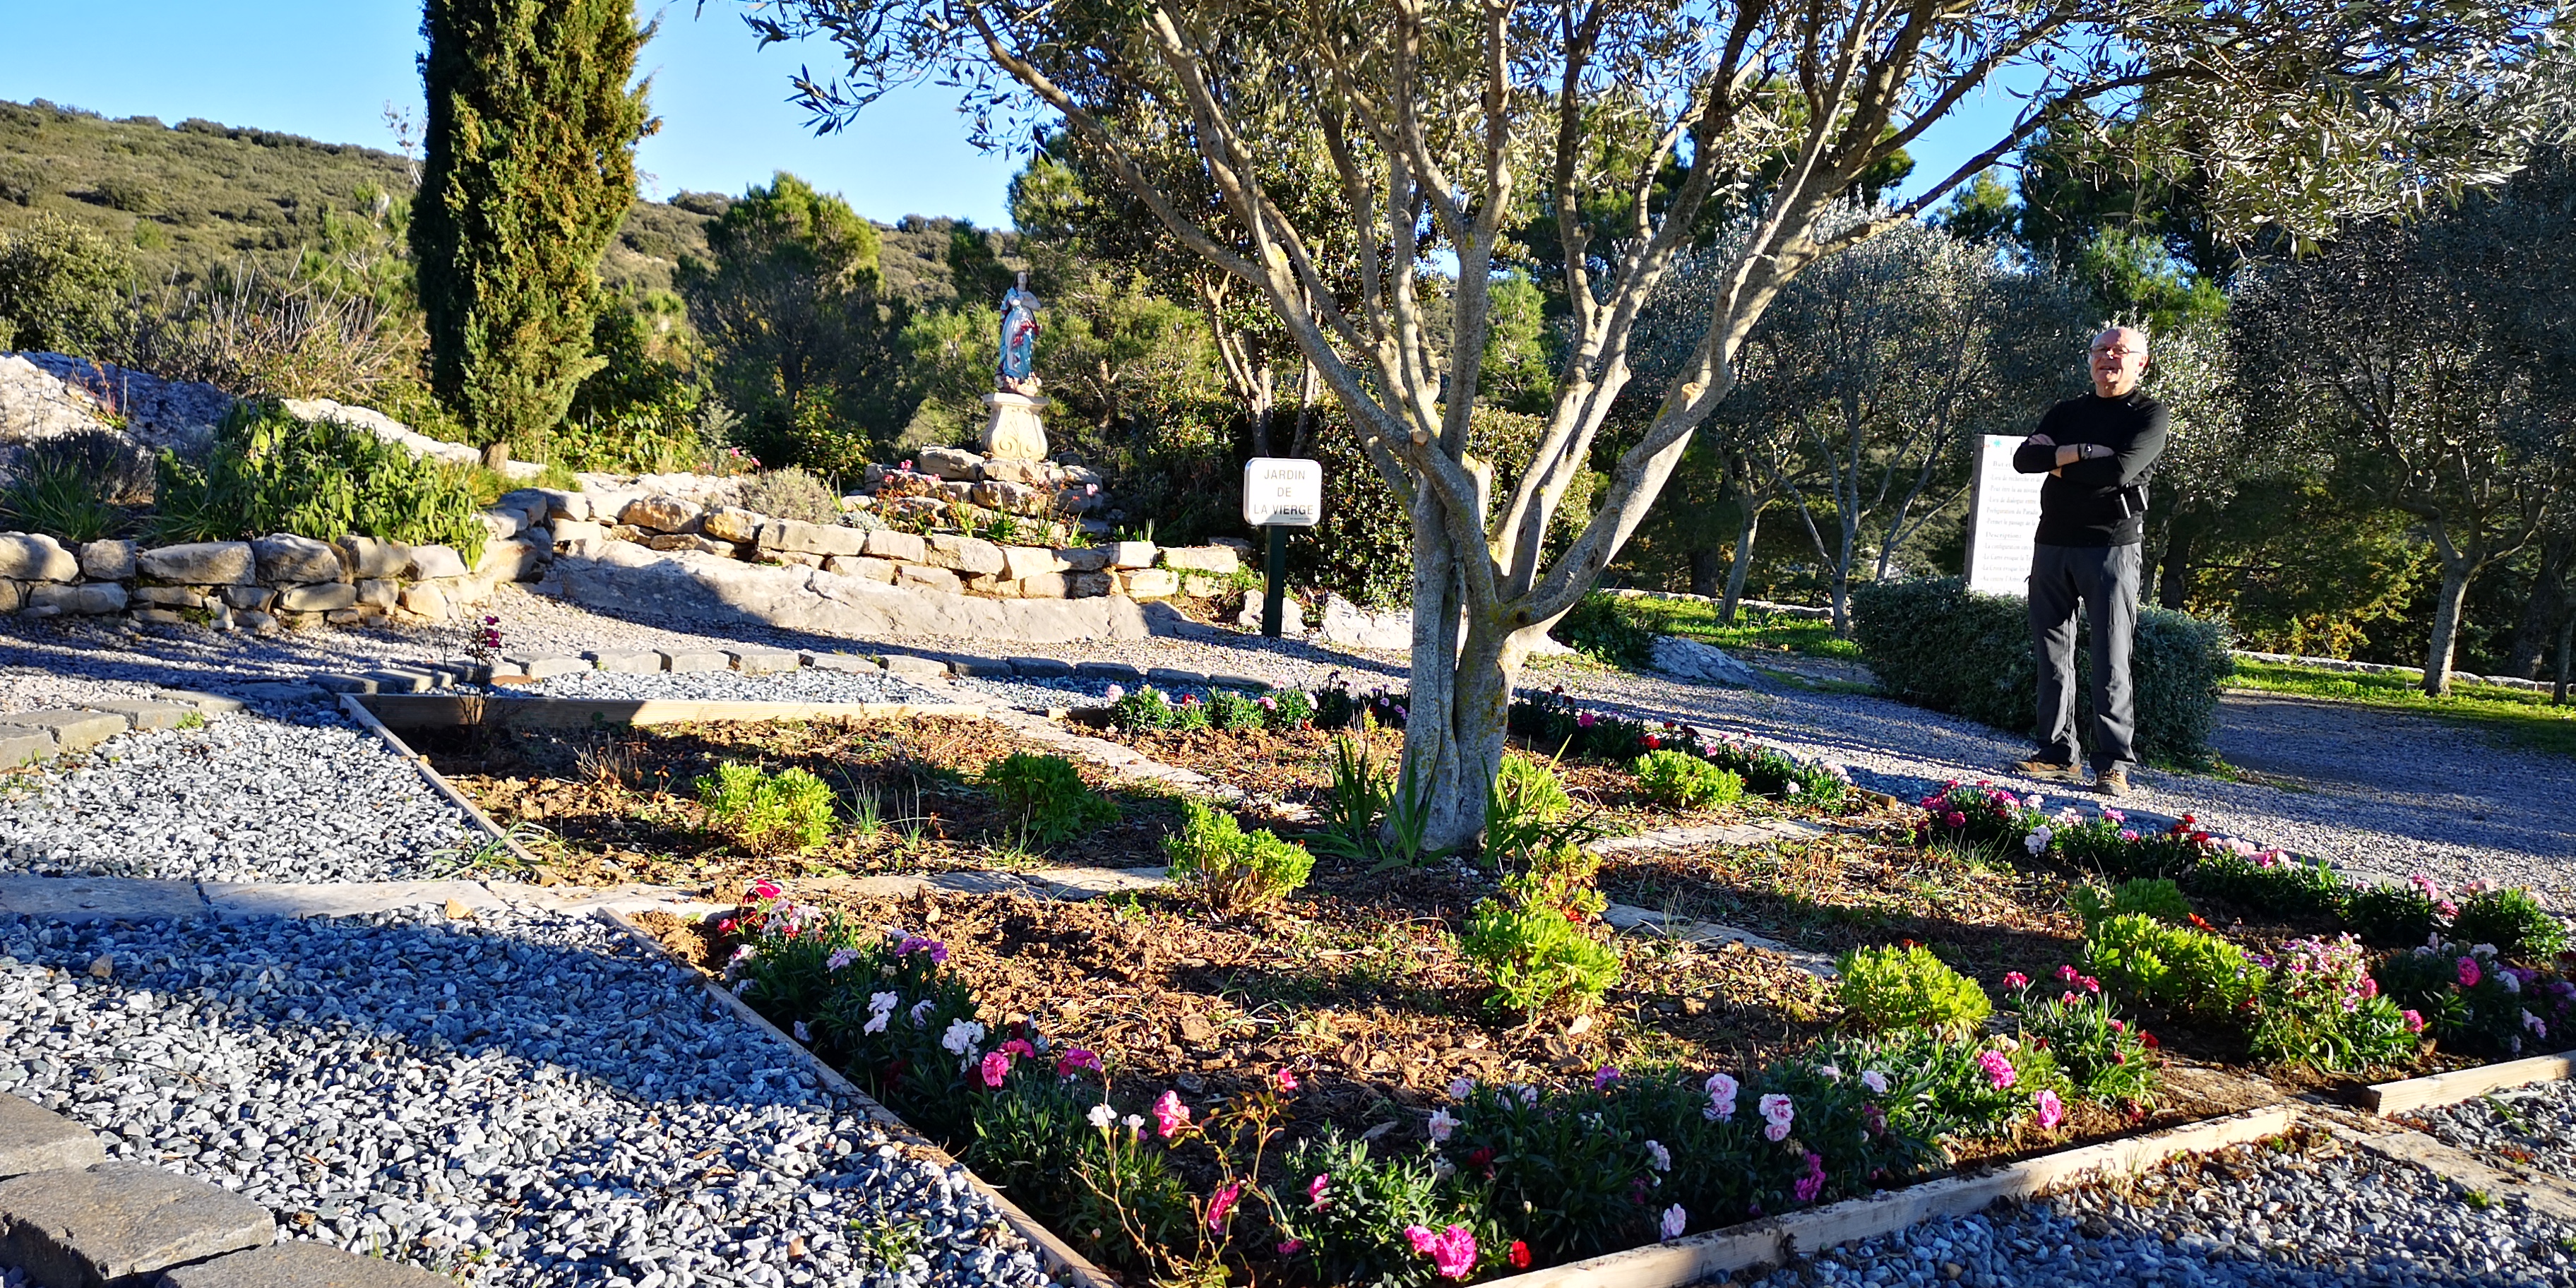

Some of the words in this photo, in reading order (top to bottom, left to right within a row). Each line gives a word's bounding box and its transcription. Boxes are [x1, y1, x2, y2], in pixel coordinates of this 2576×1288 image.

[1264, 469, 1305, 479] JARDIN
[1277, 487, 1292, 497] DE
[1254, 503, 1268, 514] LA
[1272, 504, 1313, 515] VIERGE
